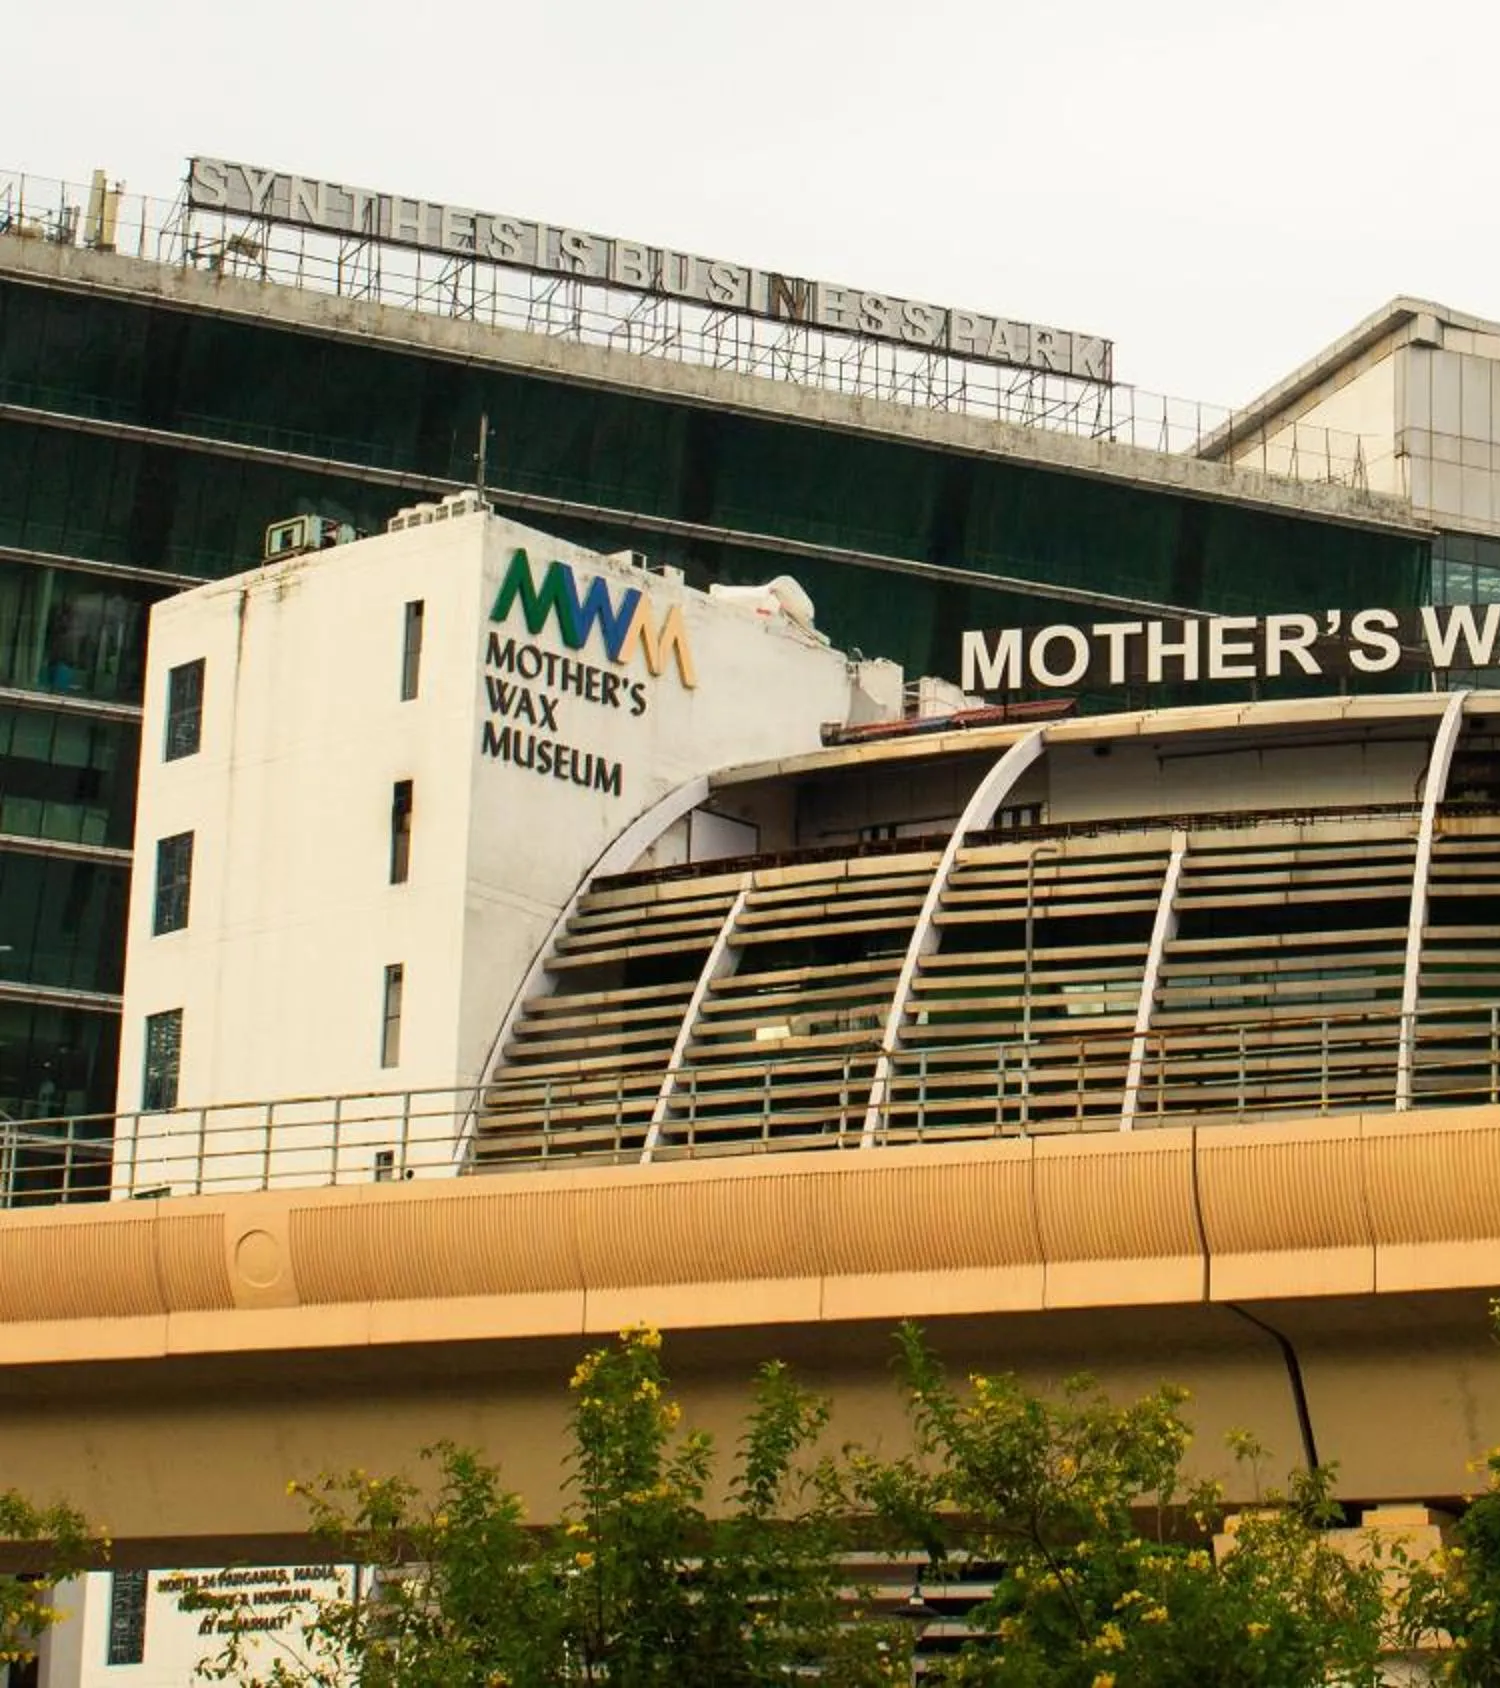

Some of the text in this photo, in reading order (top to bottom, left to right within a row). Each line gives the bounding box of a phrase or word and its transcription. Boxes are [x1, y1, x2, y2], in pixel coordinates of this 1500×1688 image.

[192, 158, 1106, 376] SYNTHESIS BUSINESS PARK
[490, 547, 698, 688] MWM
[960, 608, 1400, 690] MOTHER'S
[486, 632, 646, 716] MOTHER'S
[486, 676, 559, 732] WAX
[481, 722, 622, 796] MUSEUM
